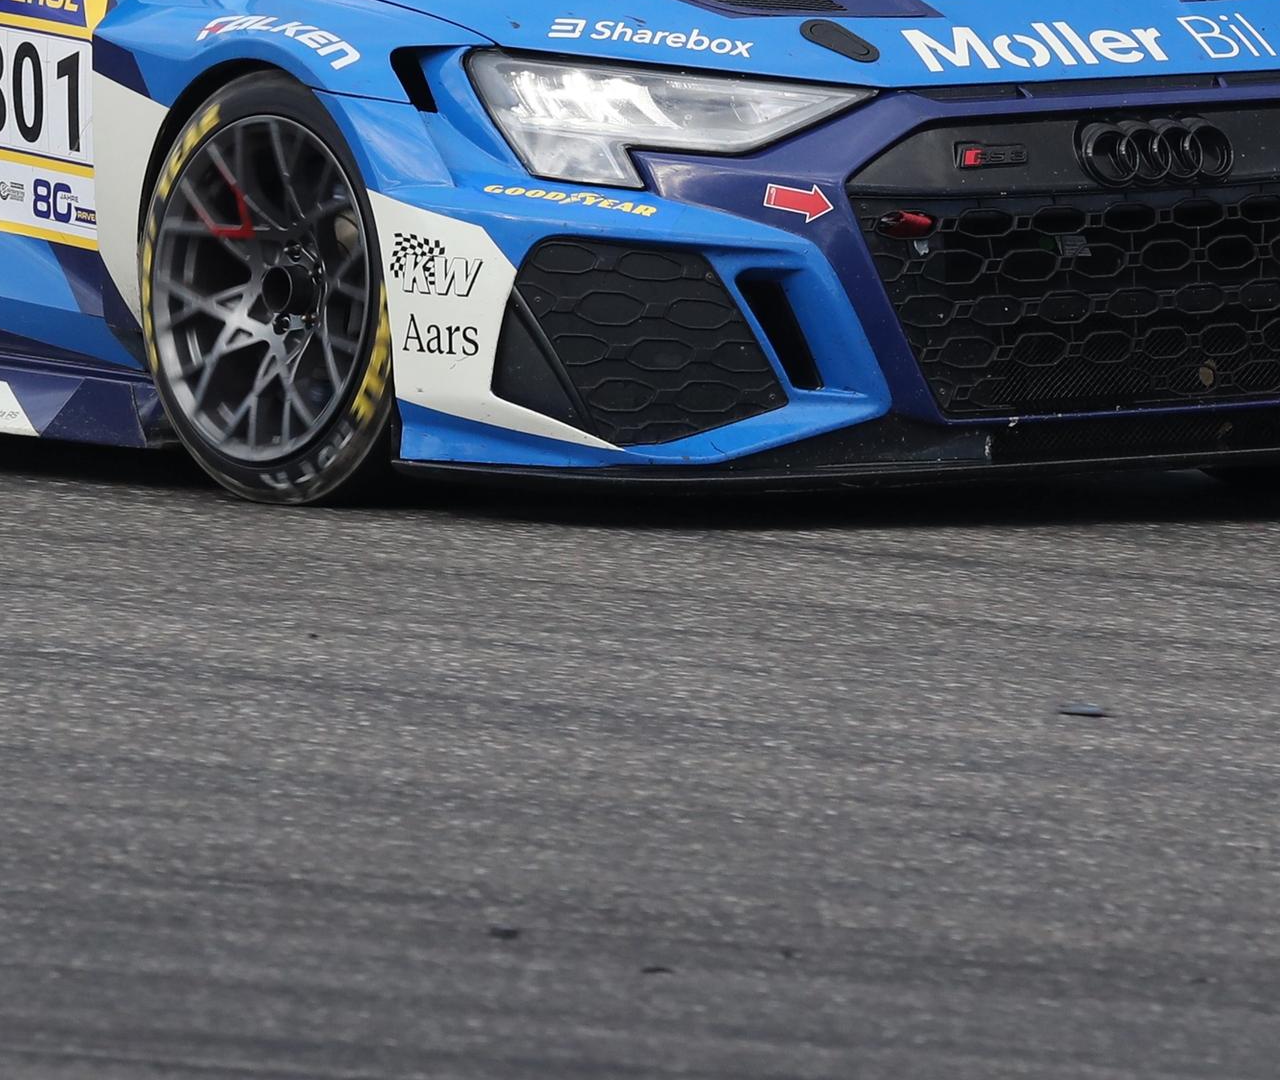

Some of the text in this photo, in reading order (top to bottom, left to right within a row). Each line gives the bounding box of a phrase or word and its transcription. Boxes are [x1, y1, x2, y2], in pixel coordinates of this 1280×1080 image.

[195, 15, 361, 70] FALKEN
[590, 20, 754, 58] Sharebox
[1176, 12, 1278, 59] Bil
[33, 178, 72, 223] 80
[483, 184, 657, 217] GOODYEAR
[402, 253, 483, 297] KW
[402, 313, 479, 356] Aars
